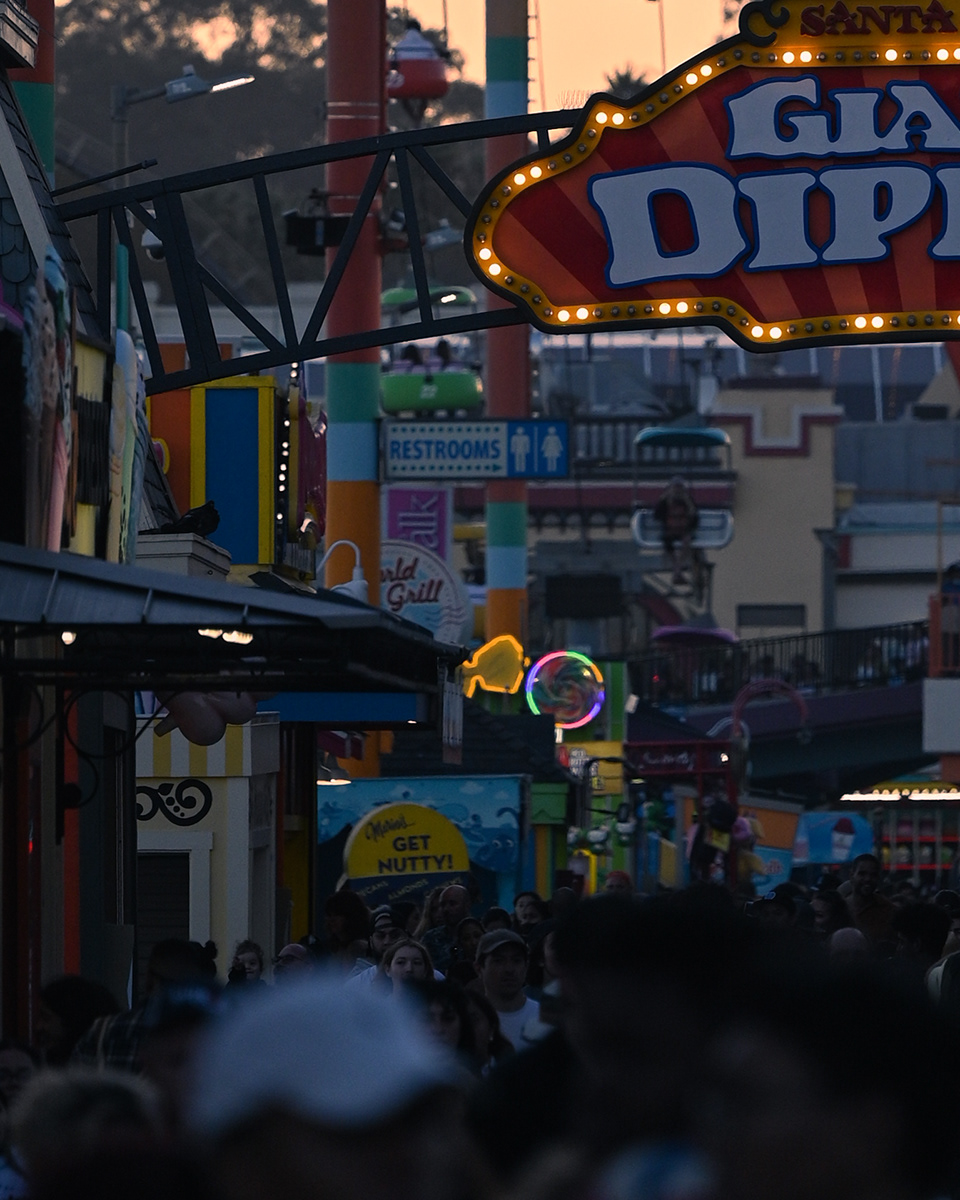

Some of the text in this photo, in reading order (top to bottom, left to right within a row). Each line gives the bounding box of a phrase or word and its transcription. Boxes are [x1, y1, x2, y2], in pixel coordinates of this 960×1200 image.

[800, 0, 958, 37] SANTA
[390, 439, 501, 460] RESTROOMS
[387, 579, 443, 612] Grill
[392, 835, 430, 852] GET
[378, 854, 453, 873] NUTTY!
